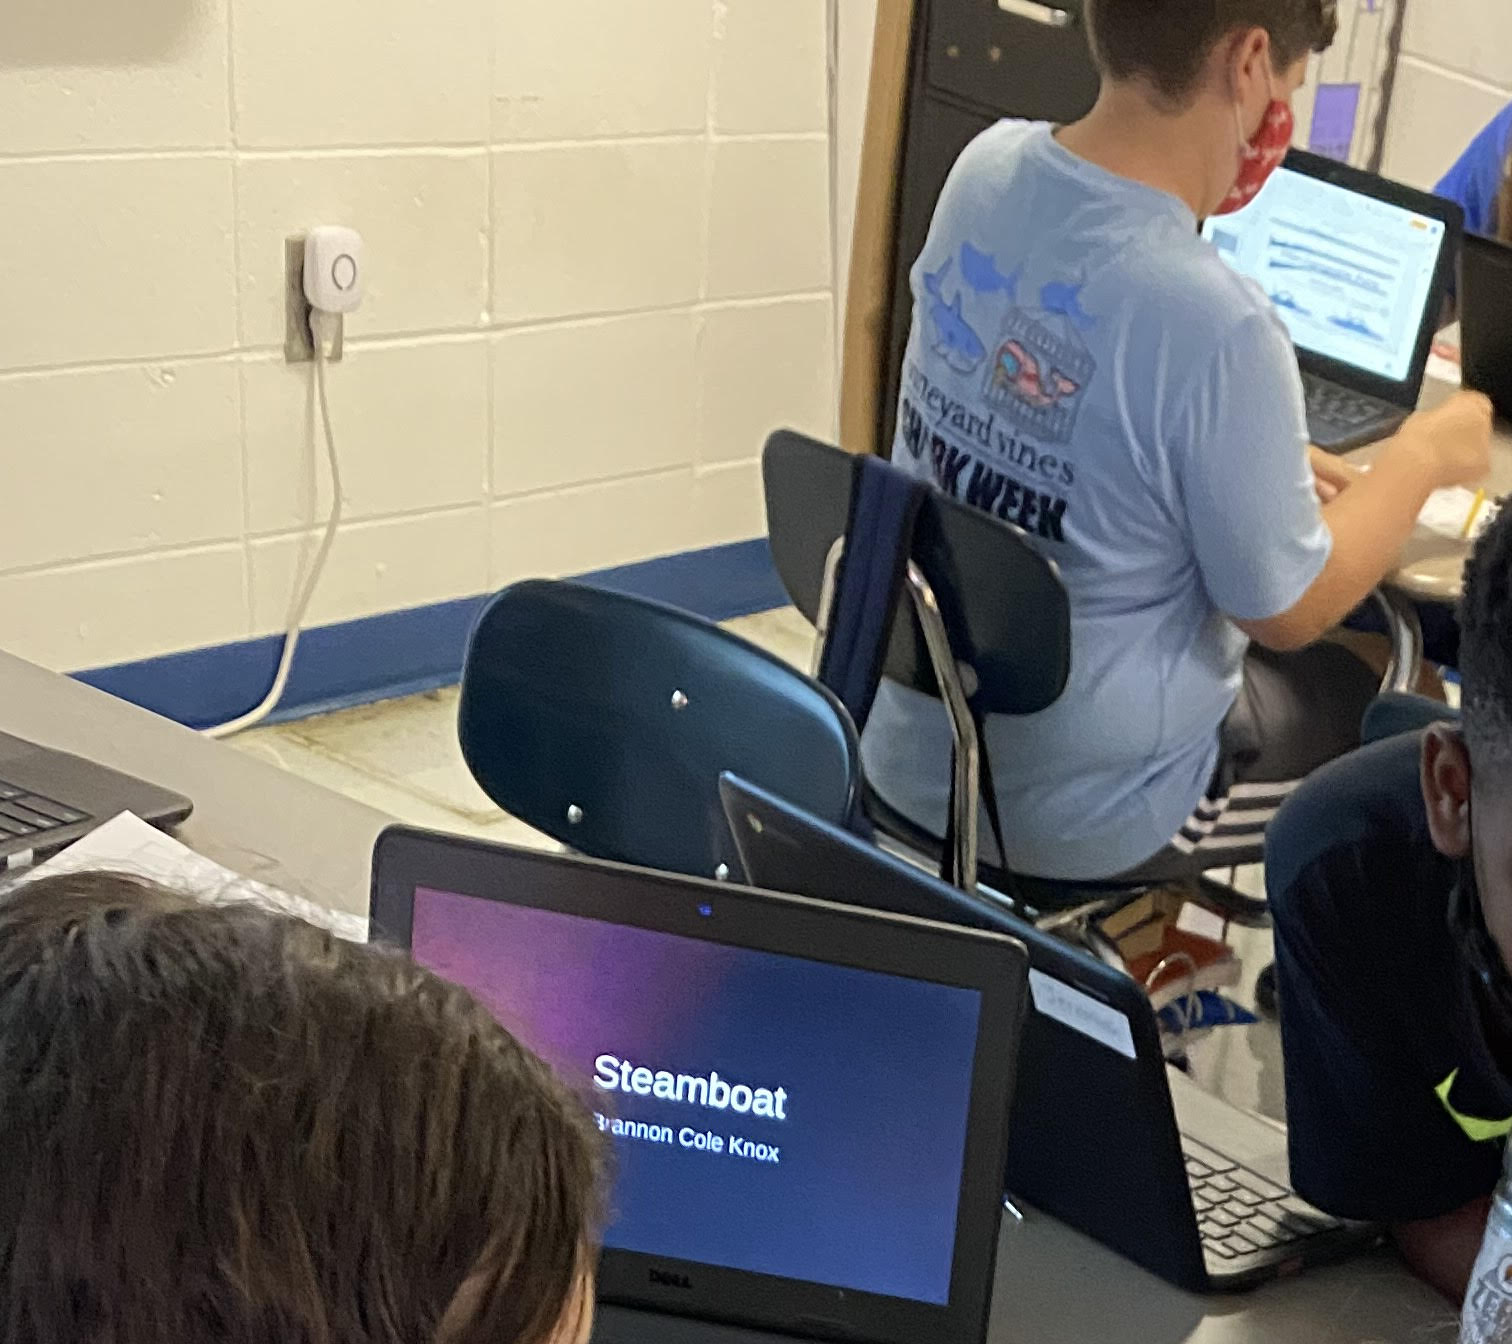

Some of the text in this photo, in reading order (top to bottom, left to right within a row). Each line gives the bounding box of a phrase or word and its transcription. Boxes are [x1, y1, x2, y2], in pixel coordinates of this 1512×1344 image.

[593, 1054, 788, 1121] Steamboat
[678, 1126, 724, 1152] Cole
[728, 1136, 780, 1164] Knox
